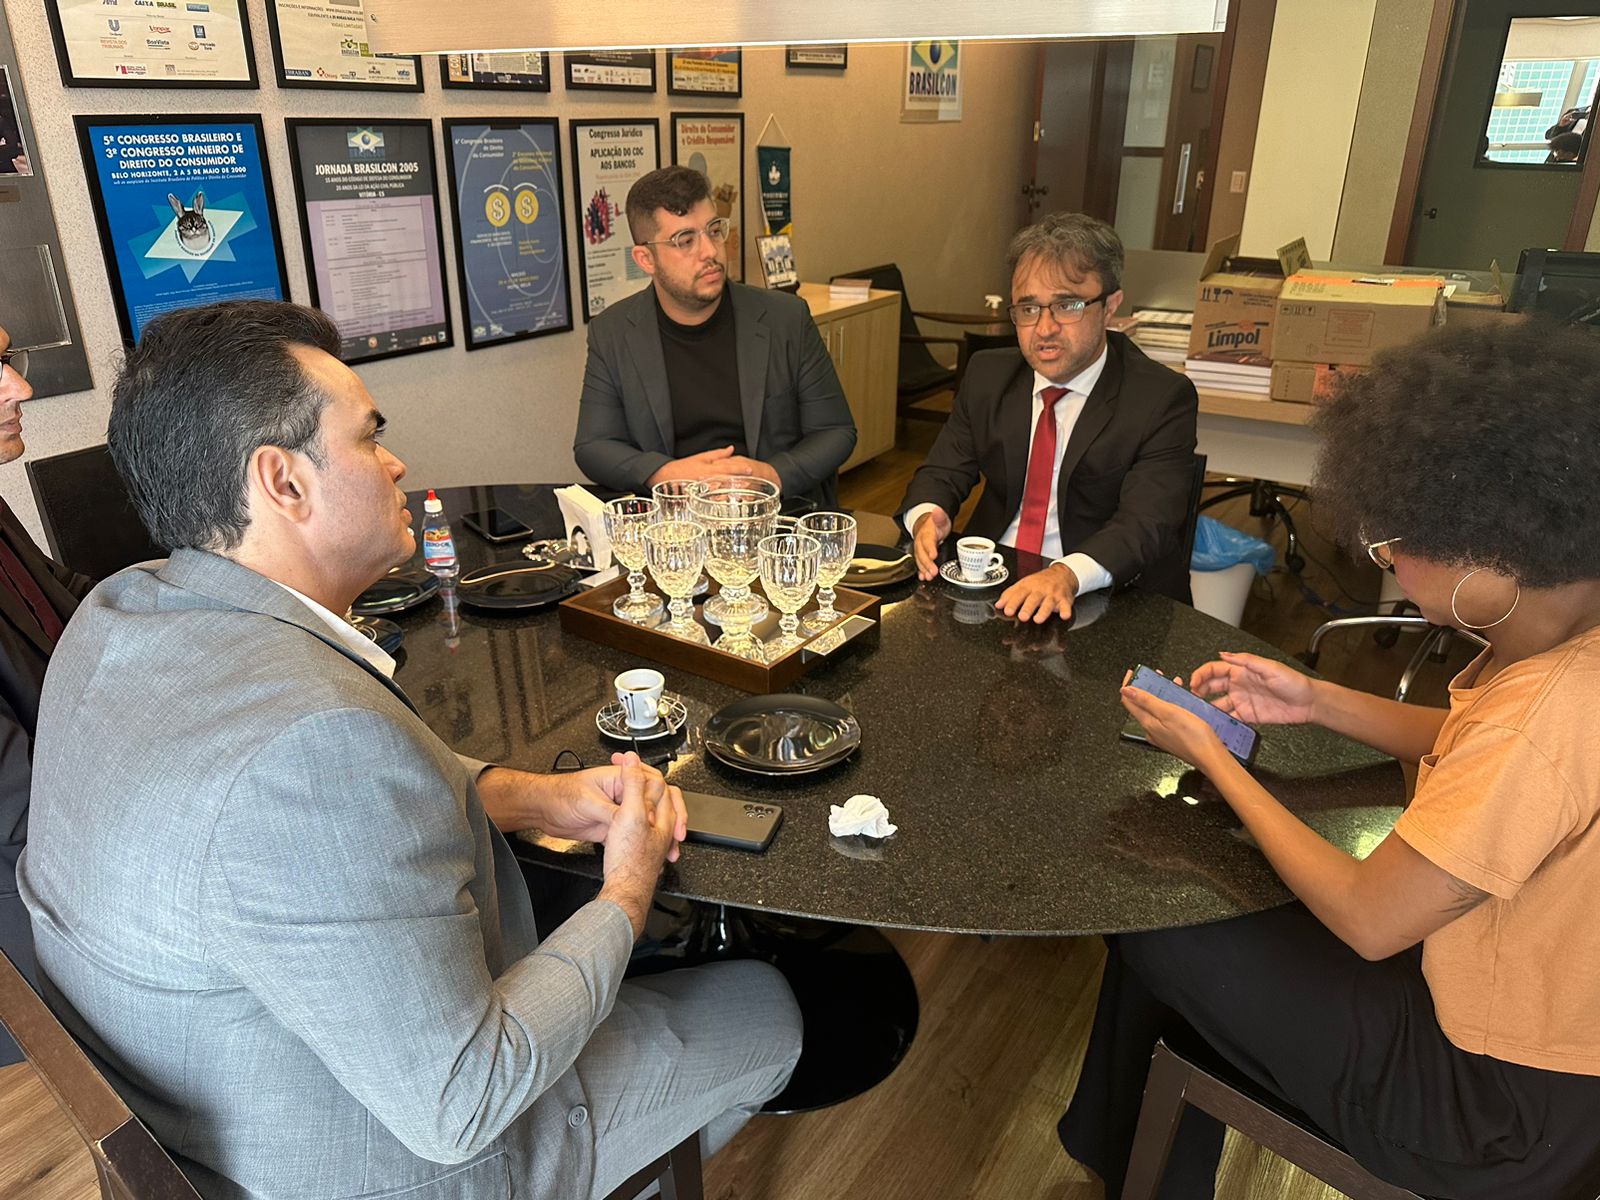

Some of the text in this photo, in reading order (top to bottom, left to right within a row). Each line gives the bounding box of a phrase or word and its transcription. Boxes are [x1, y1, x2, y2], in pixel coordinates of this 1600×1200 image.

[909, 72, 956, 96] BRASILCON
[589, 128, 643, 140] Congresso Jurídico
[681, 124, 699, 133] Direito
[707, 124, 735, 133] Consumidor
[117, 134, 179, 145] CONGRESSO
[182, 133, 234, 144] BRASILEIRO
[236, 133, 242, 142] E
[686, 135, 705, 145] Crédito
[121, 146, 184, 158] CONGRESSO
[188, 145, 229, 156] MINEIRO
[232, 144, 244, 154] DE
[590, 146, 644, 159] APLICAÇÃO DO CDC
[120, 156, 236, 170] DIREITO DO CONSUMIDOR
[315, 162, 419, 176] JORNADA BRASILCON 2005
[601, 160, 636, 170] AOS BANCOS
[358, 190, 376, 198] VITÓRIA
[1208, 328, 1260, 348] Limpol
